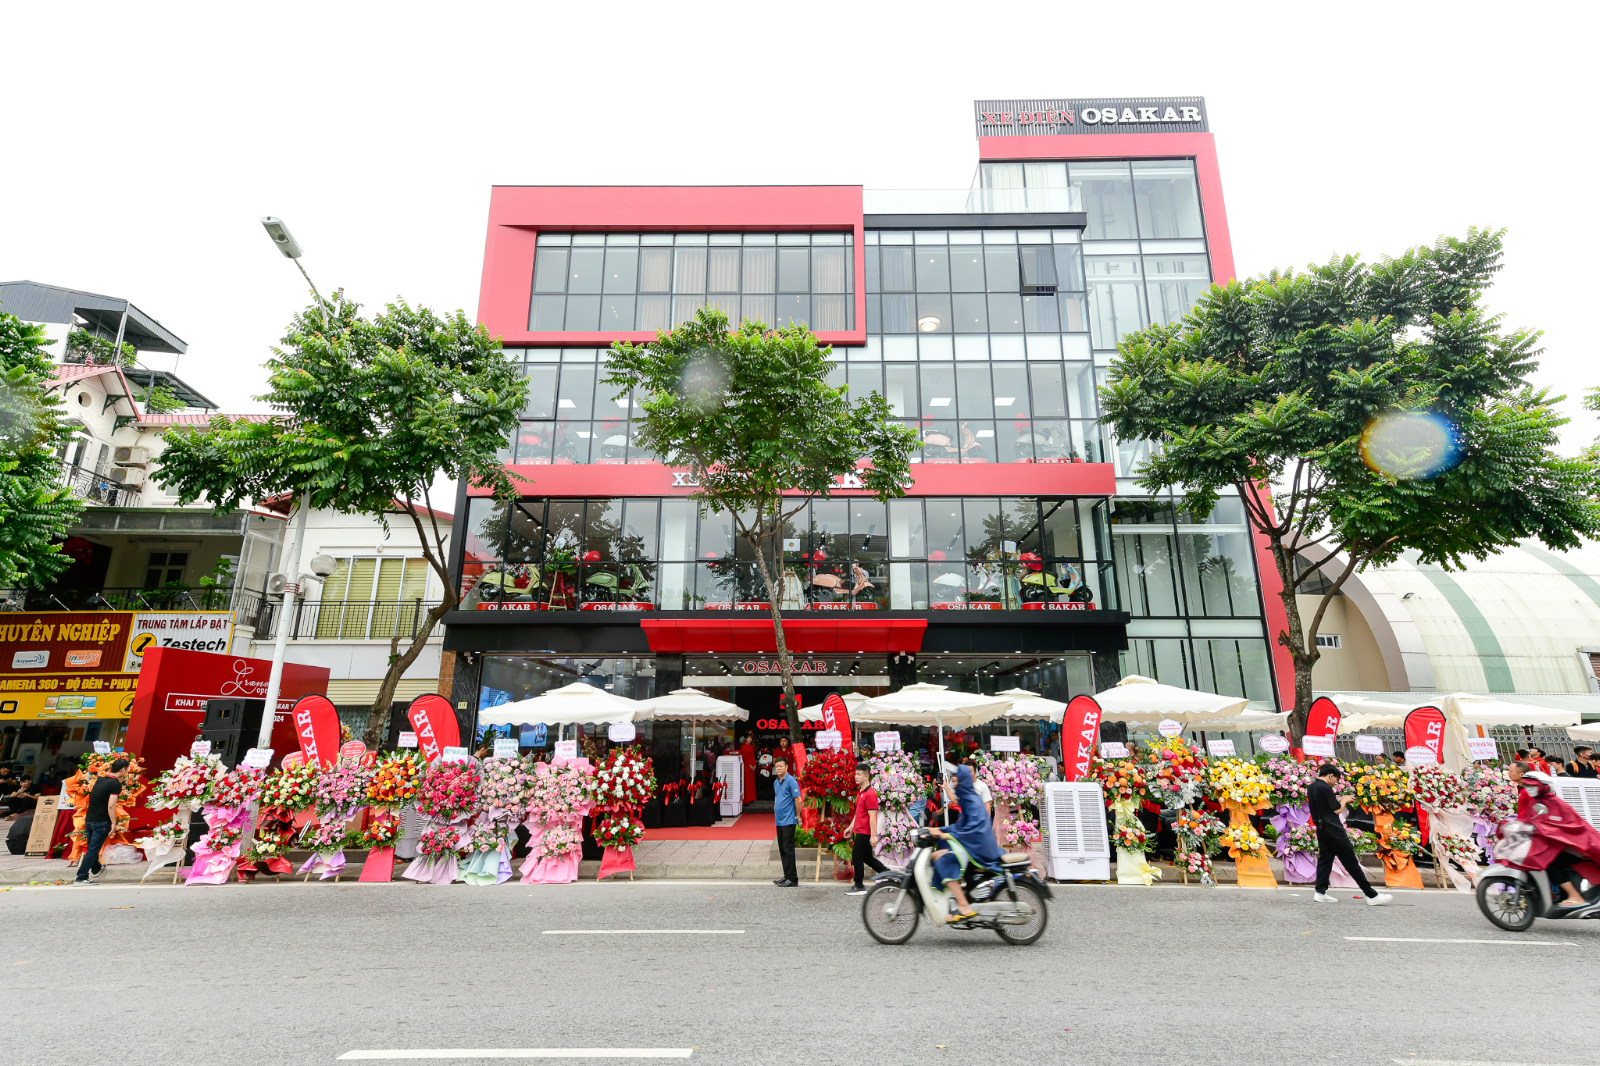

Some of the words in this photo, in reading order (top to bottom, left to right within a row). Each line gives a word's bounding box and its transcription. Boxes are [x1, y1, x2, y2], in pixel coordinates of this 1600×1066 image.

[982, 112, 1012, 125] XE
[1019, 106, 1075, 129] ĐIỆN
[1081, 107, 1202, 124] OSAKAR
[138, 619, 166, 629] TRUNG
[170, 618, 188, 629] TÂM
[190, 616, 208, 629] LẮP
[210, 619, 228, 631] ĐẶT
[57, 618, 121, 645] NGHIỆP
[162, 638, 226, 651] Zestech
[743, 661, 828, 673] OSAKAR
[0, 680, 36, 691] AMERA
[38, 679, 59, 690] 360
[81, 677, 104, 690] ĐÈN
[175, 698, 194, 707] KHAI
[756, 718, 825, 730] OSAAR
